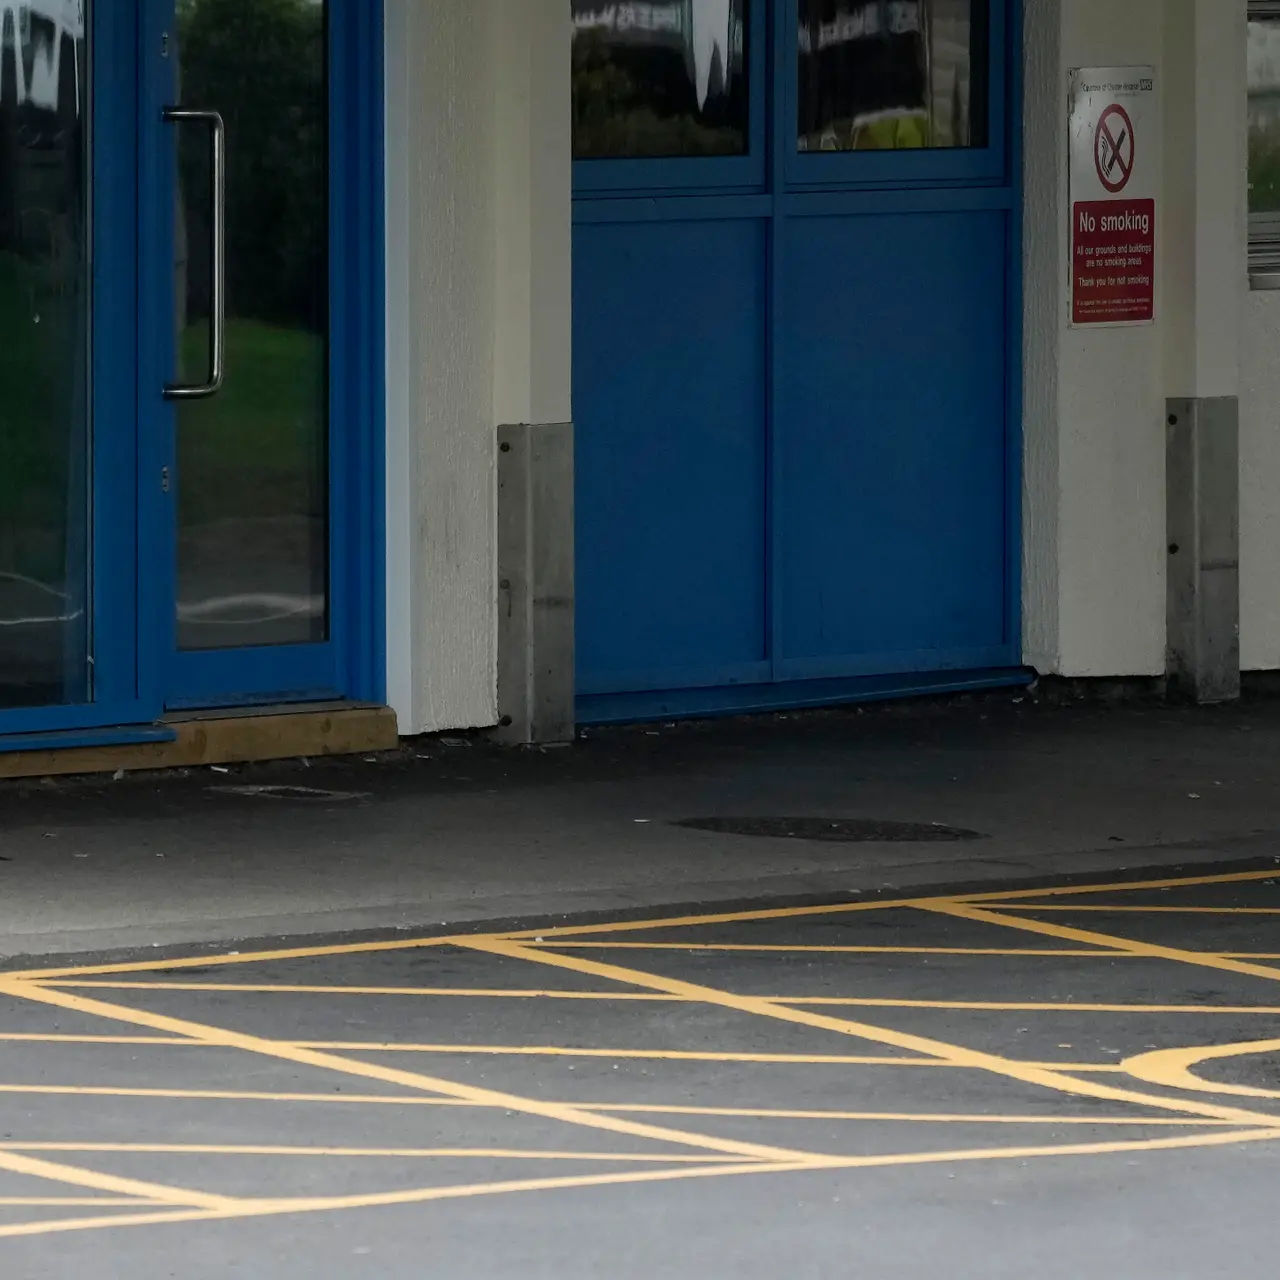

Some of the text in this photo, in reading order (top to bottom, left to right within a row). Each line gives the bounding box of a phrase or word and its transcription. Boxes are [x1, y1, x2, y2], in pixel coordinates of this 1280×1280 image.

[1079, 210, 1149, 235] No smoking
[1085, 247, 1094, 255] our
[1095, 245, 1116, 256] grounds
[1118, 244, 1127, 254] and
[1129, 244, 1152, 254] buildings
[1086, 257, 1142, 268] are no smoking areas
[1079, 277, 1094, 287] Thank
[1096, 279, 1106, 288] you
[1117, 276, 1126, 285] not
[1127, 275, 1149, 286] smoking
